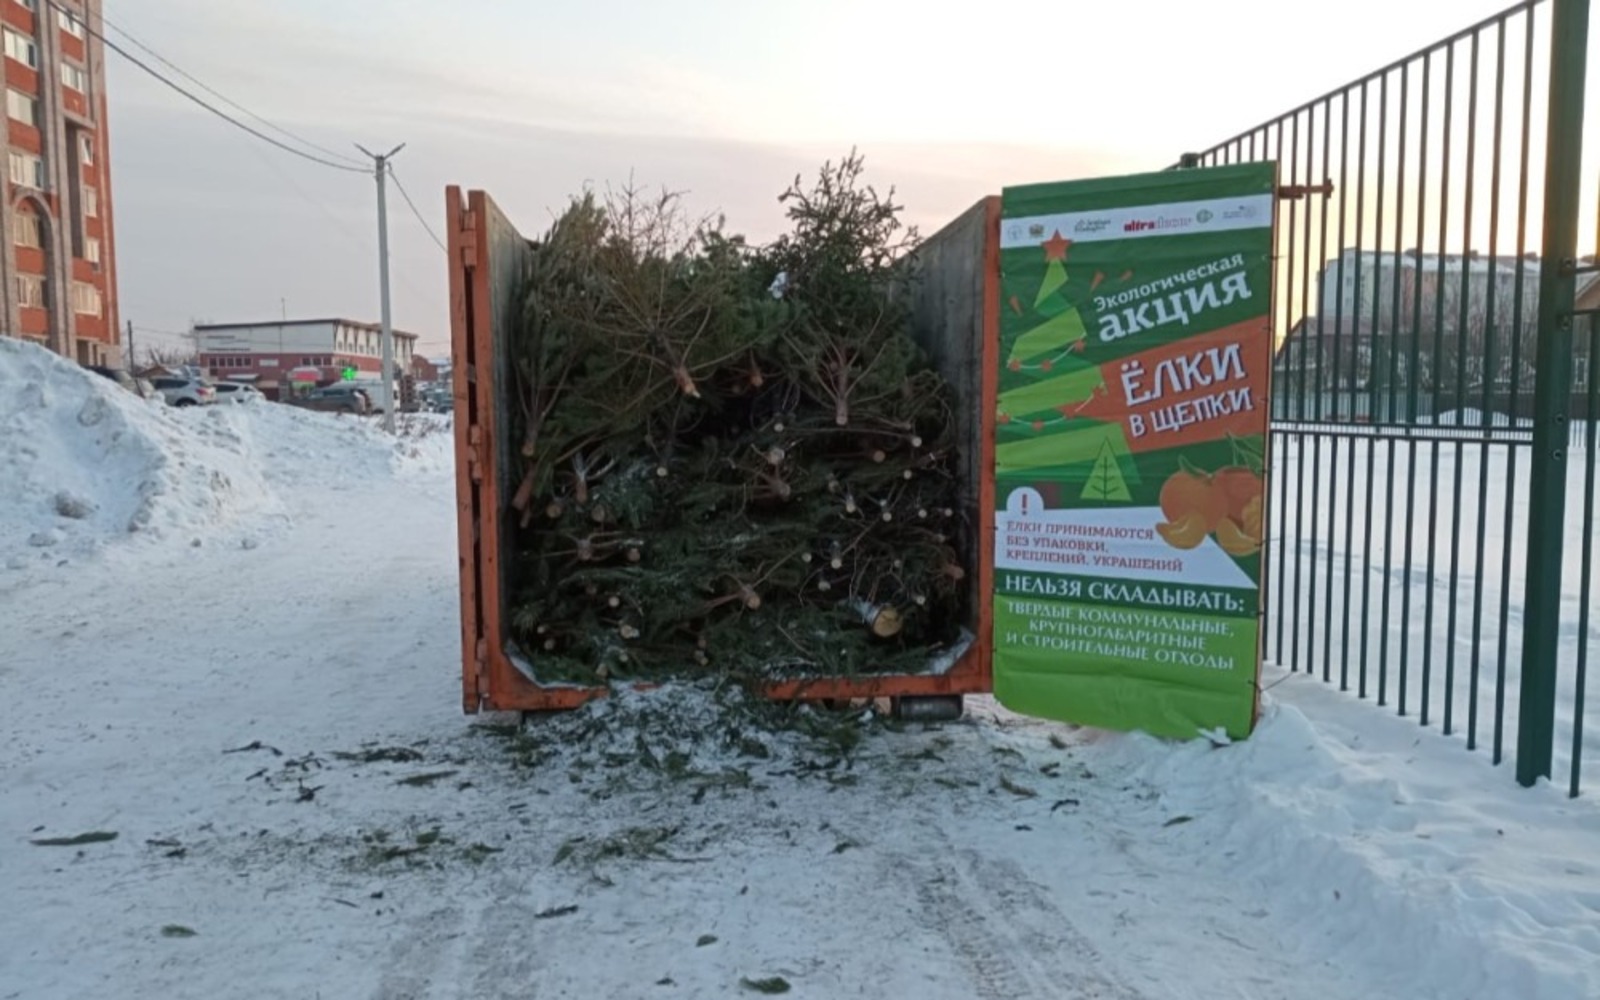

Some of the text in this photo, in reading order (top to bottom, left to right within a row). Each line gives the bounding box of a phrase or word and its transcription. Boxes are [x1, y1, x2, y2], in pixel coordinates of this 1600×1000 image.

[1093, 253, 1245, 312] Экологическая
[1098, 271, 1252, 342] акция
[1121, 343, 1246, 407] ЁЛКИ
[1151, 387, 1254, 432] ЩЕПКИ
[1006, 535, 1109, 553] БЕЗ УПАКОВКИ,
[1045, 523, 1154, 540] ПРИНИМАЮТСЯ
[1006, 549, 1183, 572] КРЕПЛЕНИЙ, УКРАШЕНИЙ
[1005, 575, 1245, 612] НЕЛЬЗЯ СКЛАДЫВАТЬ:
[1008, 602, 1235, 637] ТВЕРДЫЕ КОММУНАЛЬНЫЕ,
[1029, 619, 1207, 650] КРУПНОГАБАРИТНЫЕ
[1006, 632, 1234, 670] И СТРОИТЕЛЬНЫЕ ОТХОДЫ
